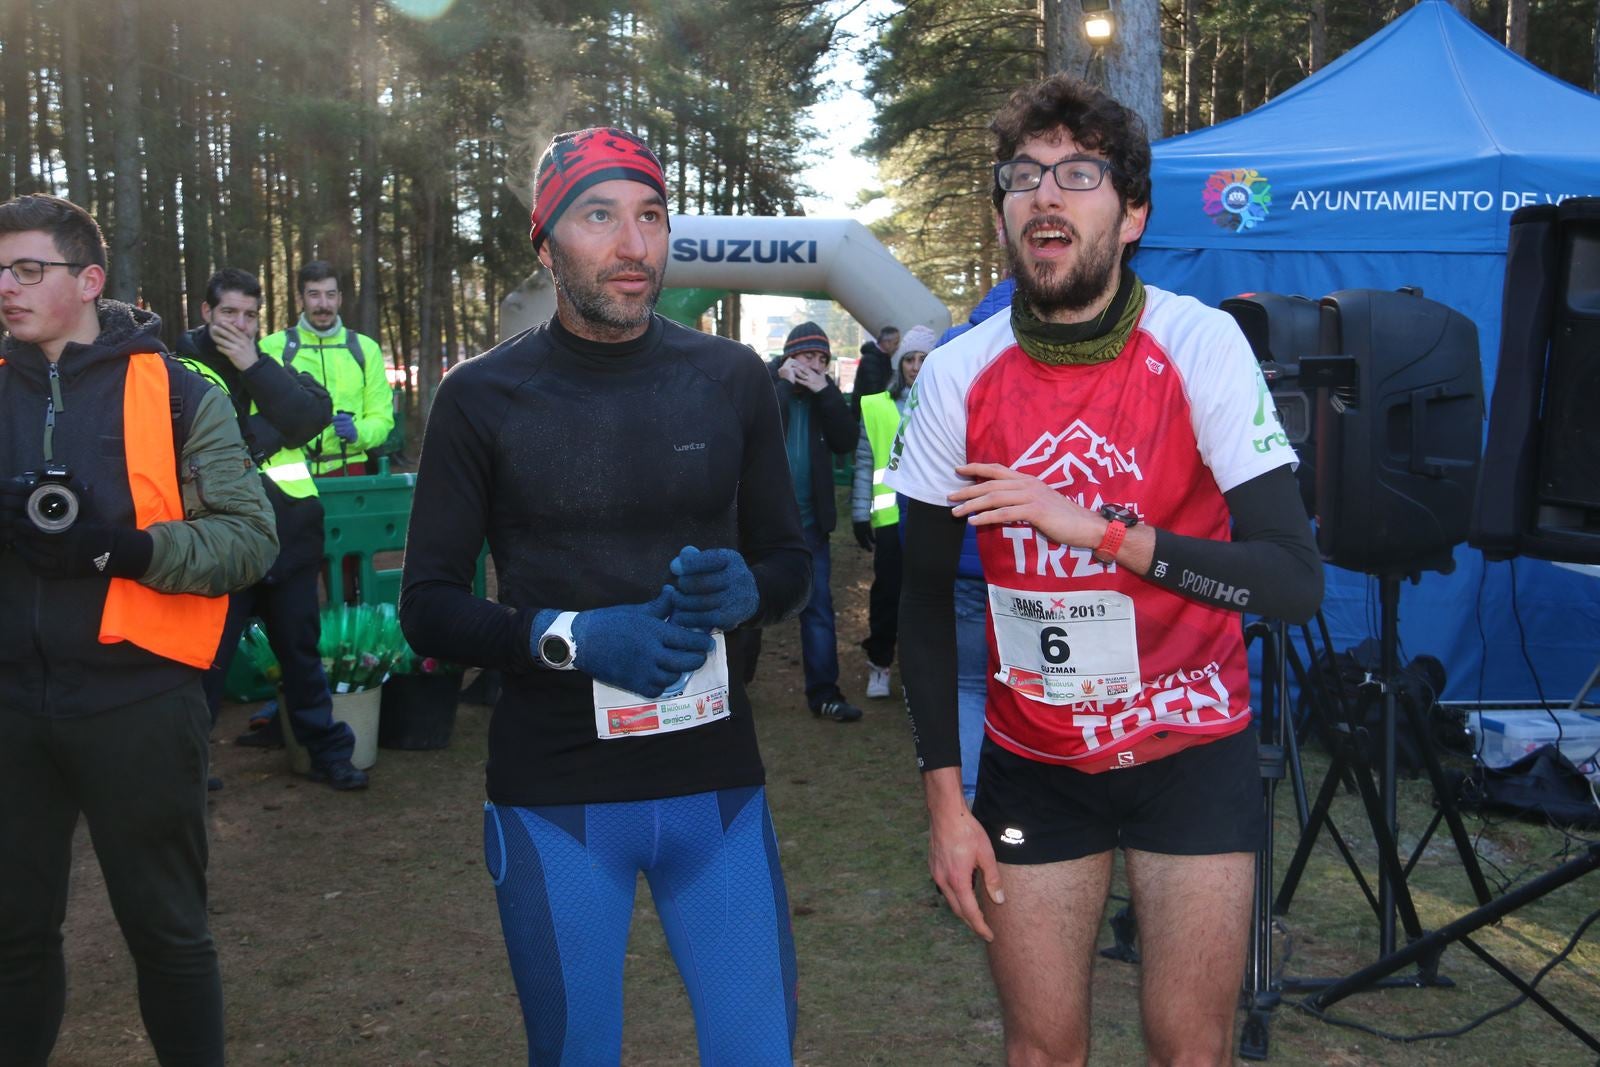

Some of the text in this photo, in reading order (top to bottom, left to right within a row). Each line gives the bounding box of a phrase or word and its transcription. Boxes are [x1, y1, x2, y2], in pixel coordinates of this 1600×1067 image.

[1291, 190, 1494, 211] AYUNTAMIENTO
[672, 238, 817, 263] SUZUKI
[1069, 604, 1106, 618] 2019
[1040, 626, 1071, 664] 6
[1041, 665, 1077, 674] GUZMAN
